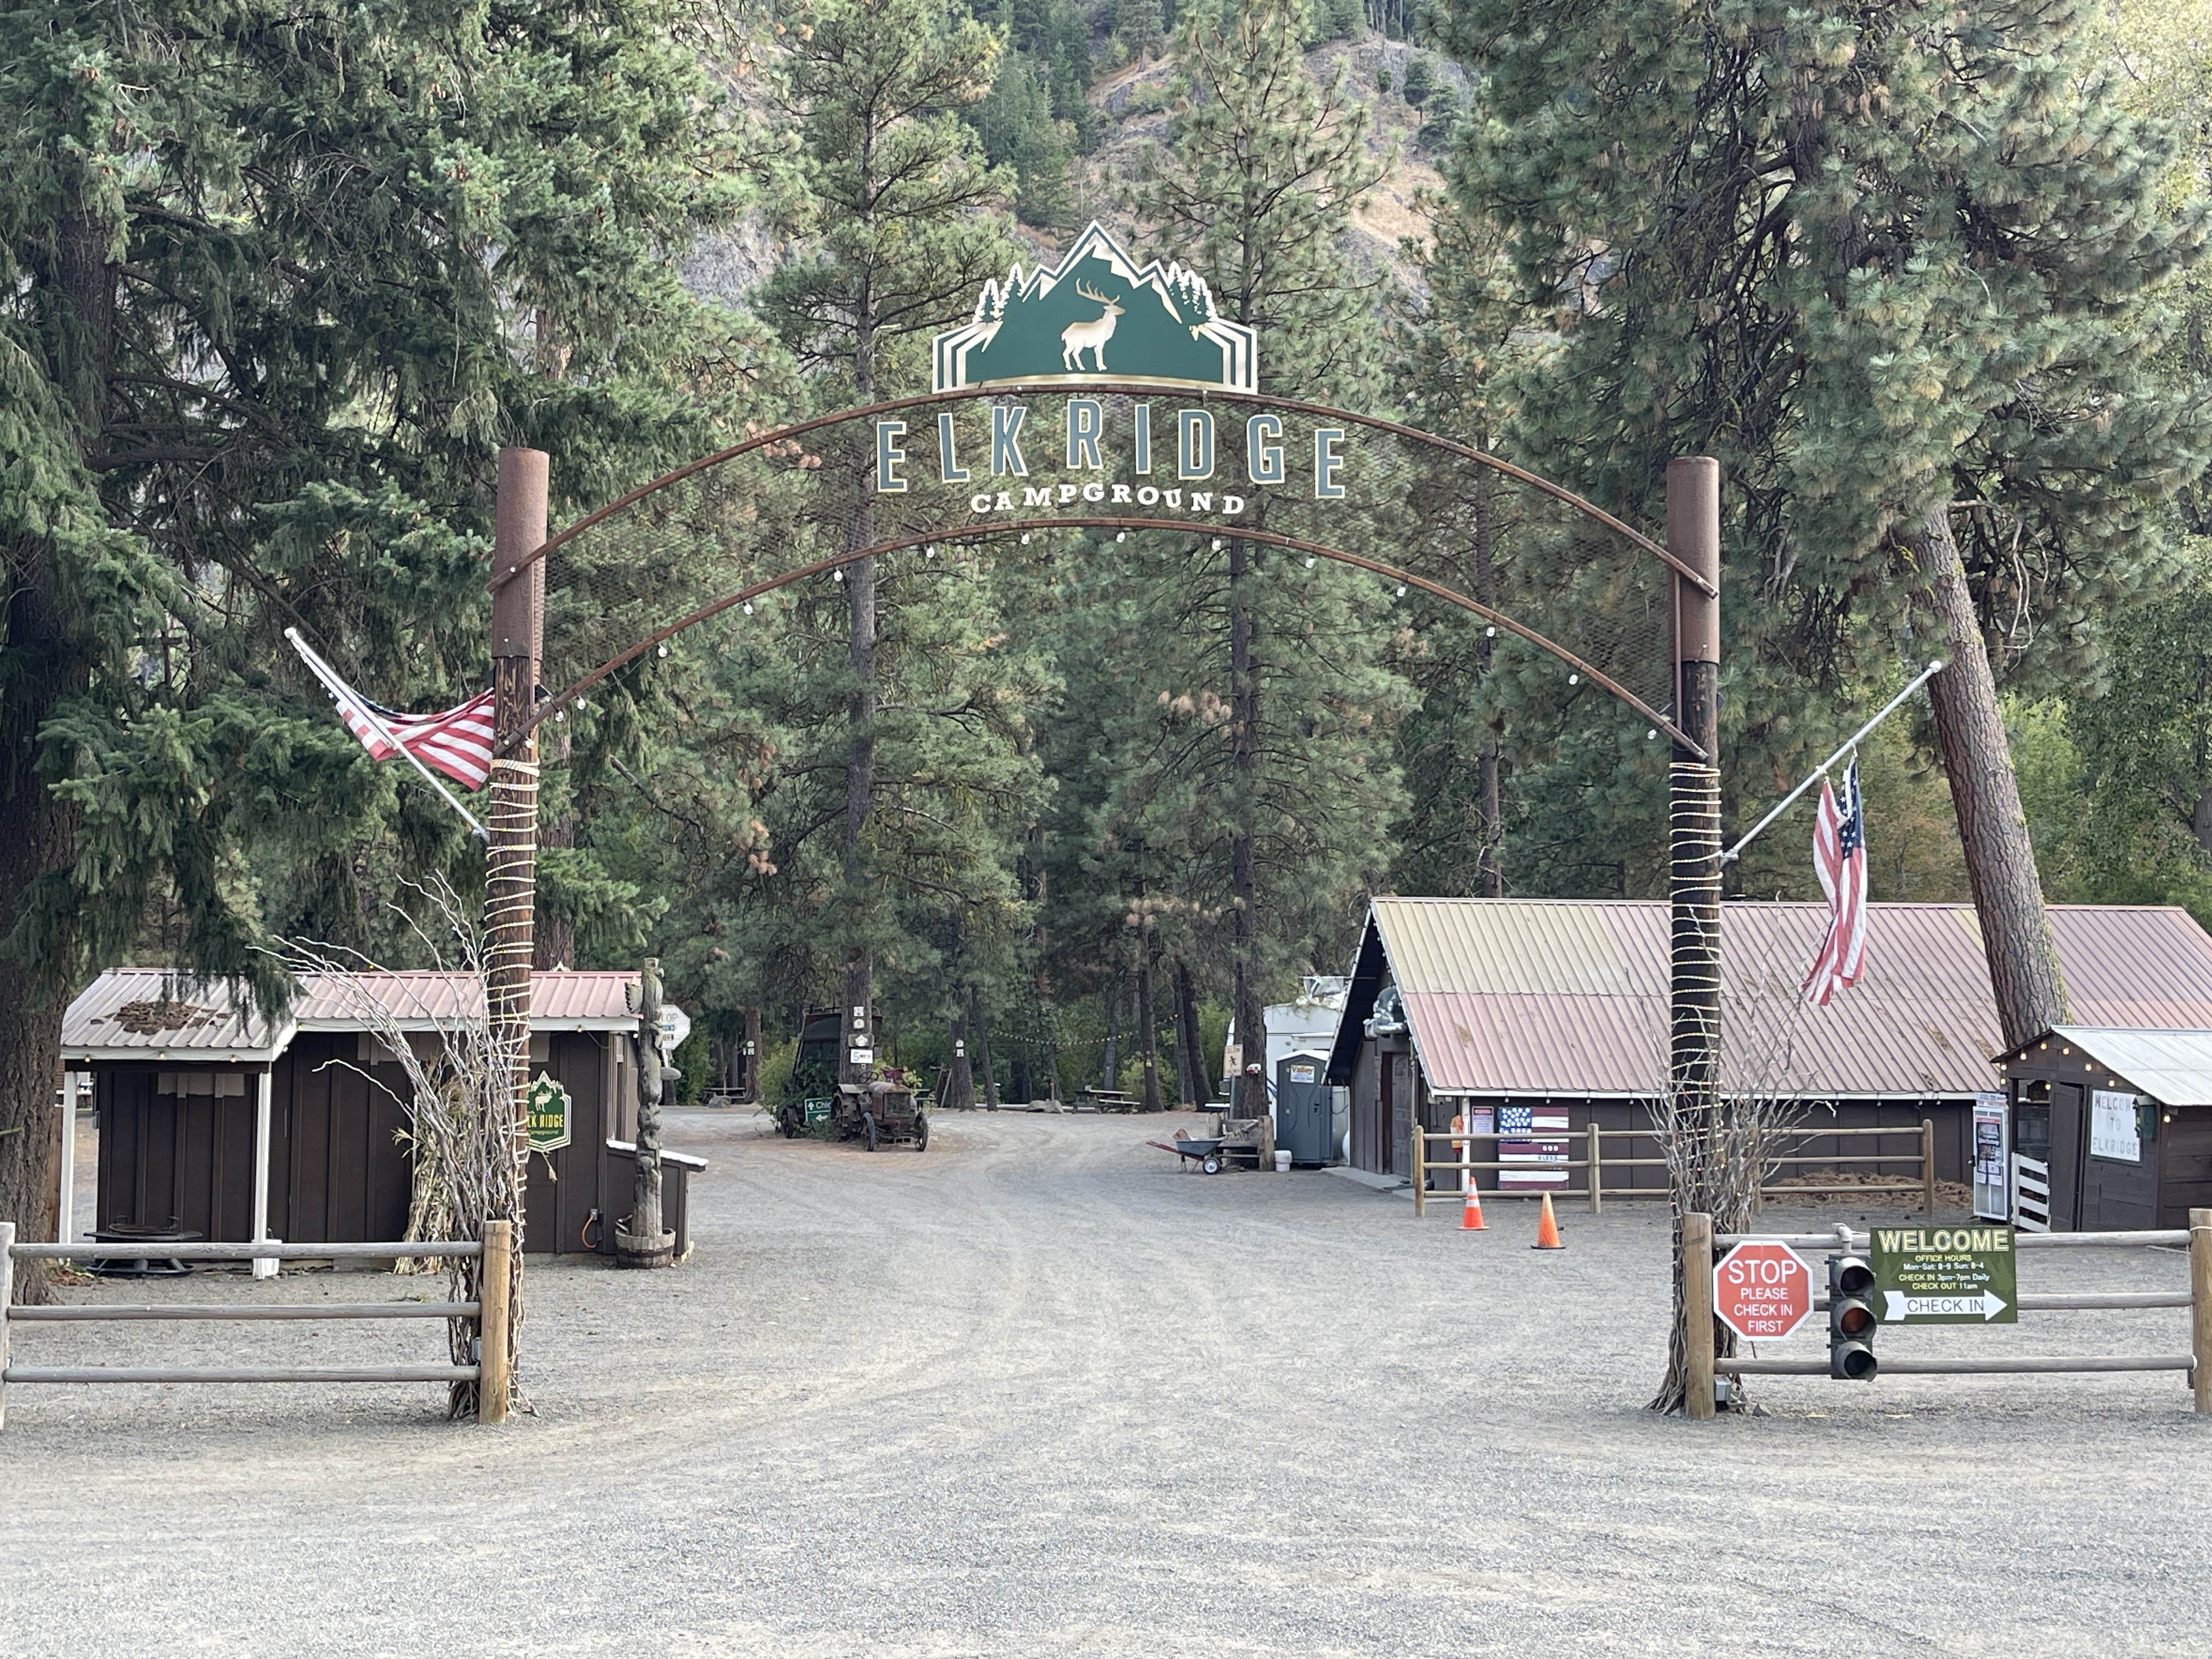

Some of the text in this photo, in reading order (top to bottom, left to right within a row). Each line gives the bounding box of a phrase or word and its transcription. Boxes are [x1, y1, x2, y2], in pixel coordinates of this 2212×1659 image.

[970, 483, 1245, 515] CAMPGROUND
[853, 1052, 859, 1062] 5
[2095, 1094, 2131, 1111] WELCOM
[539, 1114, 563, 1128] RIDGE
[2110, 1118, 2121, 1131] TO
[2092, 1137, 2137, 1156] ELKRIDGE
[1877, 1229, 2010, 1253] WELCOME
[1915, 1254, 1943, 1262] OFFICE
[1728, 1260, 1797, 1284] STOP
[1937, 1274, 1971, 1283] 3pm-7pm
[1972, 1273, 1990, 1282] Daily
[1740, 1288, 1788, 1300] PLEASE
[1734, 1304, 1793, 1317] CHECK IN
[1907, 1299, 1984, 1313] CHECK IN
[1748, 1320, 1784, 1333] FIRST
